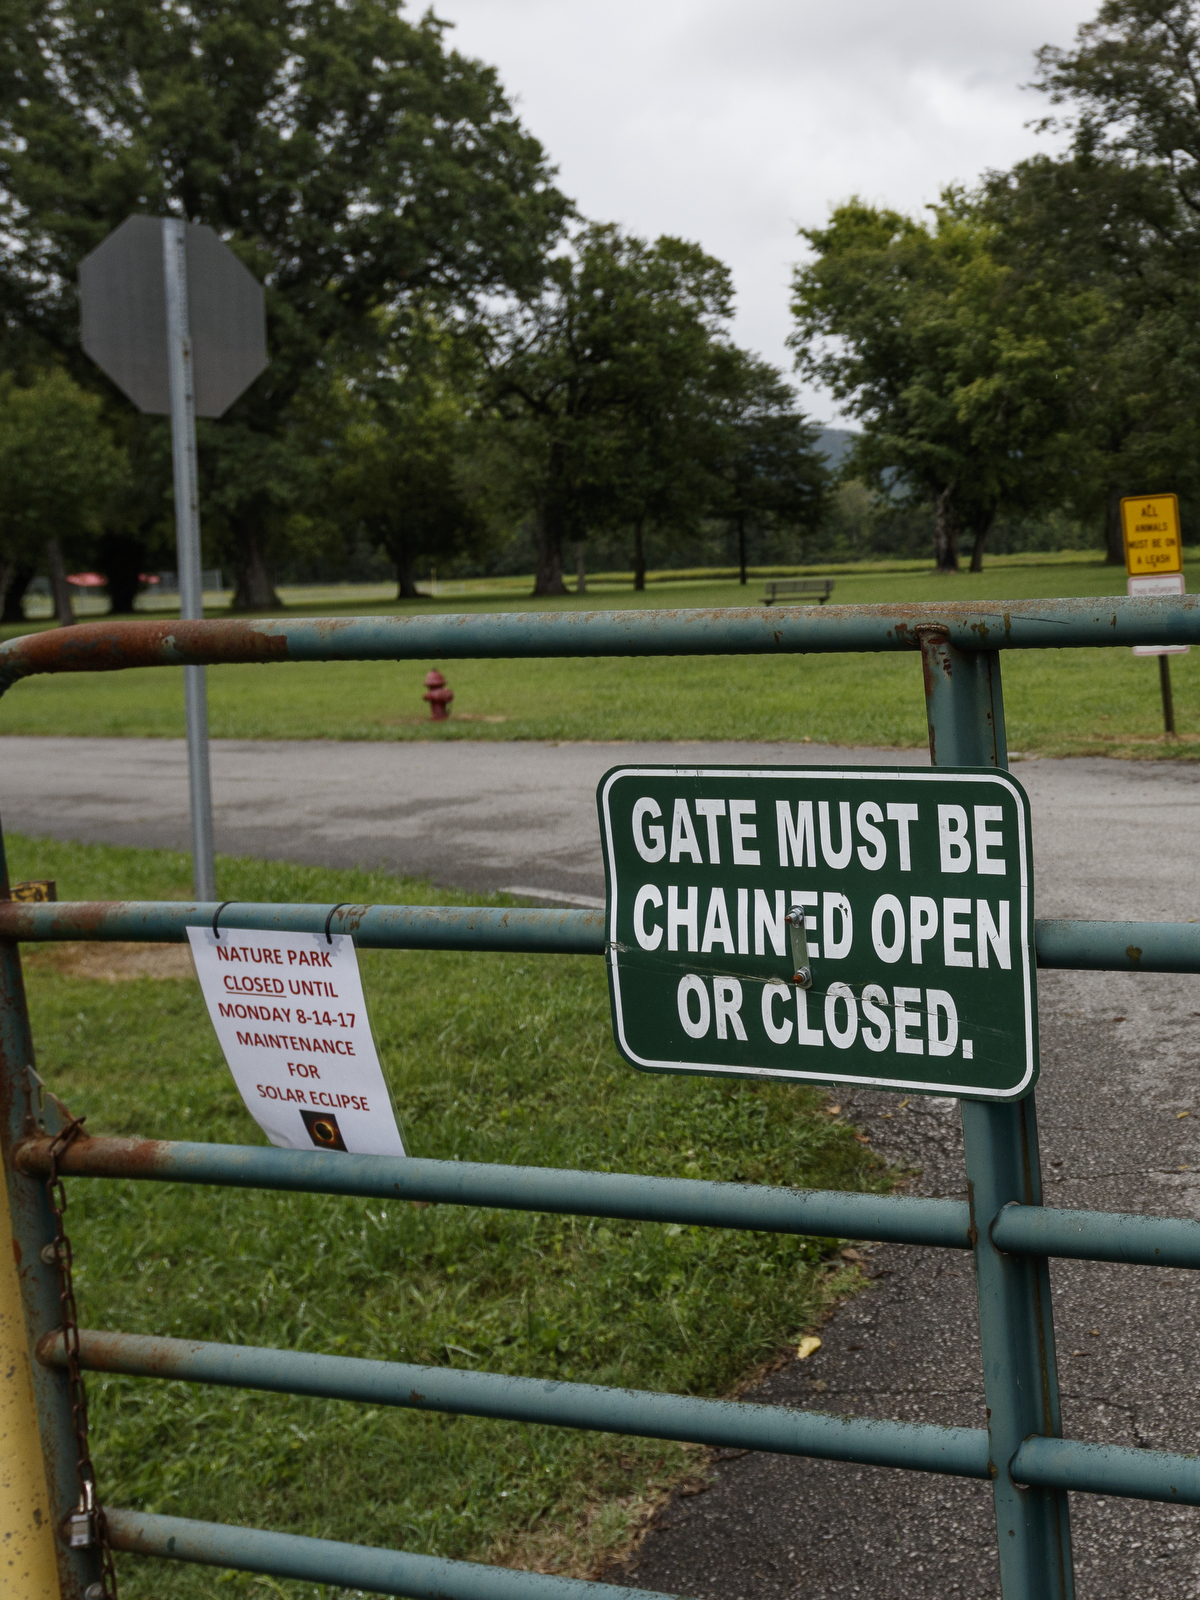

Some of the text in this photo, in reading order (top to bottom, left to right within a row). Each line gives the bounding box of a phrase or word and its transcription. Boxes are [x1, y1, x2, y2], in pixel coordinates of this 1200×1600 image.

[1141, 506, 1158, 517] ALL
[1135, 522, 1168, 533] ANIMALS
[1128, 537, 1176, 549] MUST BE ON
[1137, 554, 1171, 565] A LEASH
[632, 796, 1007, 876] GATE MUST BE
[633, 883, 1012, 970] CHAINED OPEN
[217, 946, 332, 968] NATURE PARK
[223, 974, 338, 998] CLOSED UNTIL
[218, 1002, 355, 1028] MONDAY 8-14-17
[676, 973, 974, 1060] OR CLOSED.
[236, 1031, 356, 1056] MAINTENANCE
[287, 1062, 320, 1079] FOR
[256, 1084, 370, 1111] SOLAR ECLIPSE
